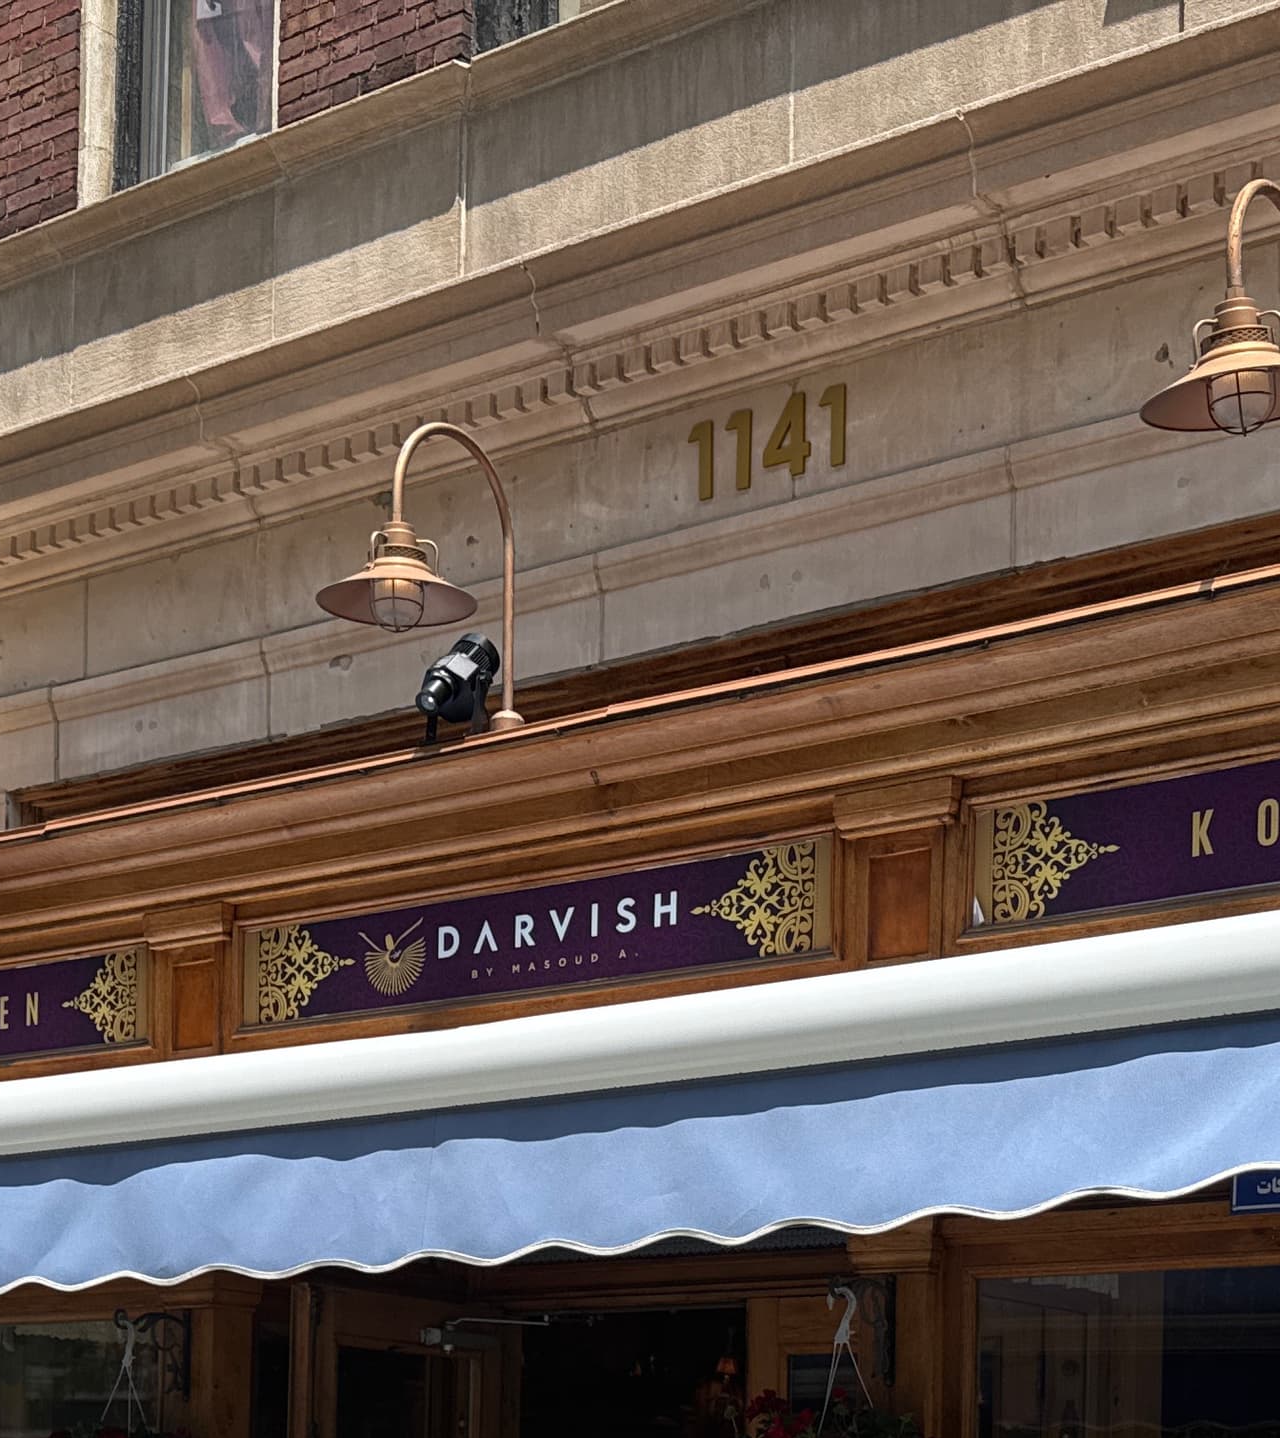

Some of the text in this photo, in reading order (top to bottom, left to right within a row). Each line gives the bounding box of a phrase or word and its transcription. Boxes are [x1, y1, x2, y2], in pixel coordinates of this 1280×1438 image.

[687, 382, 847, 501] 1141
[438, 890, 678, 961] DARVISH
[471, 967, 494, 980] BY
[511, 953, 600, 974] MASOUD
